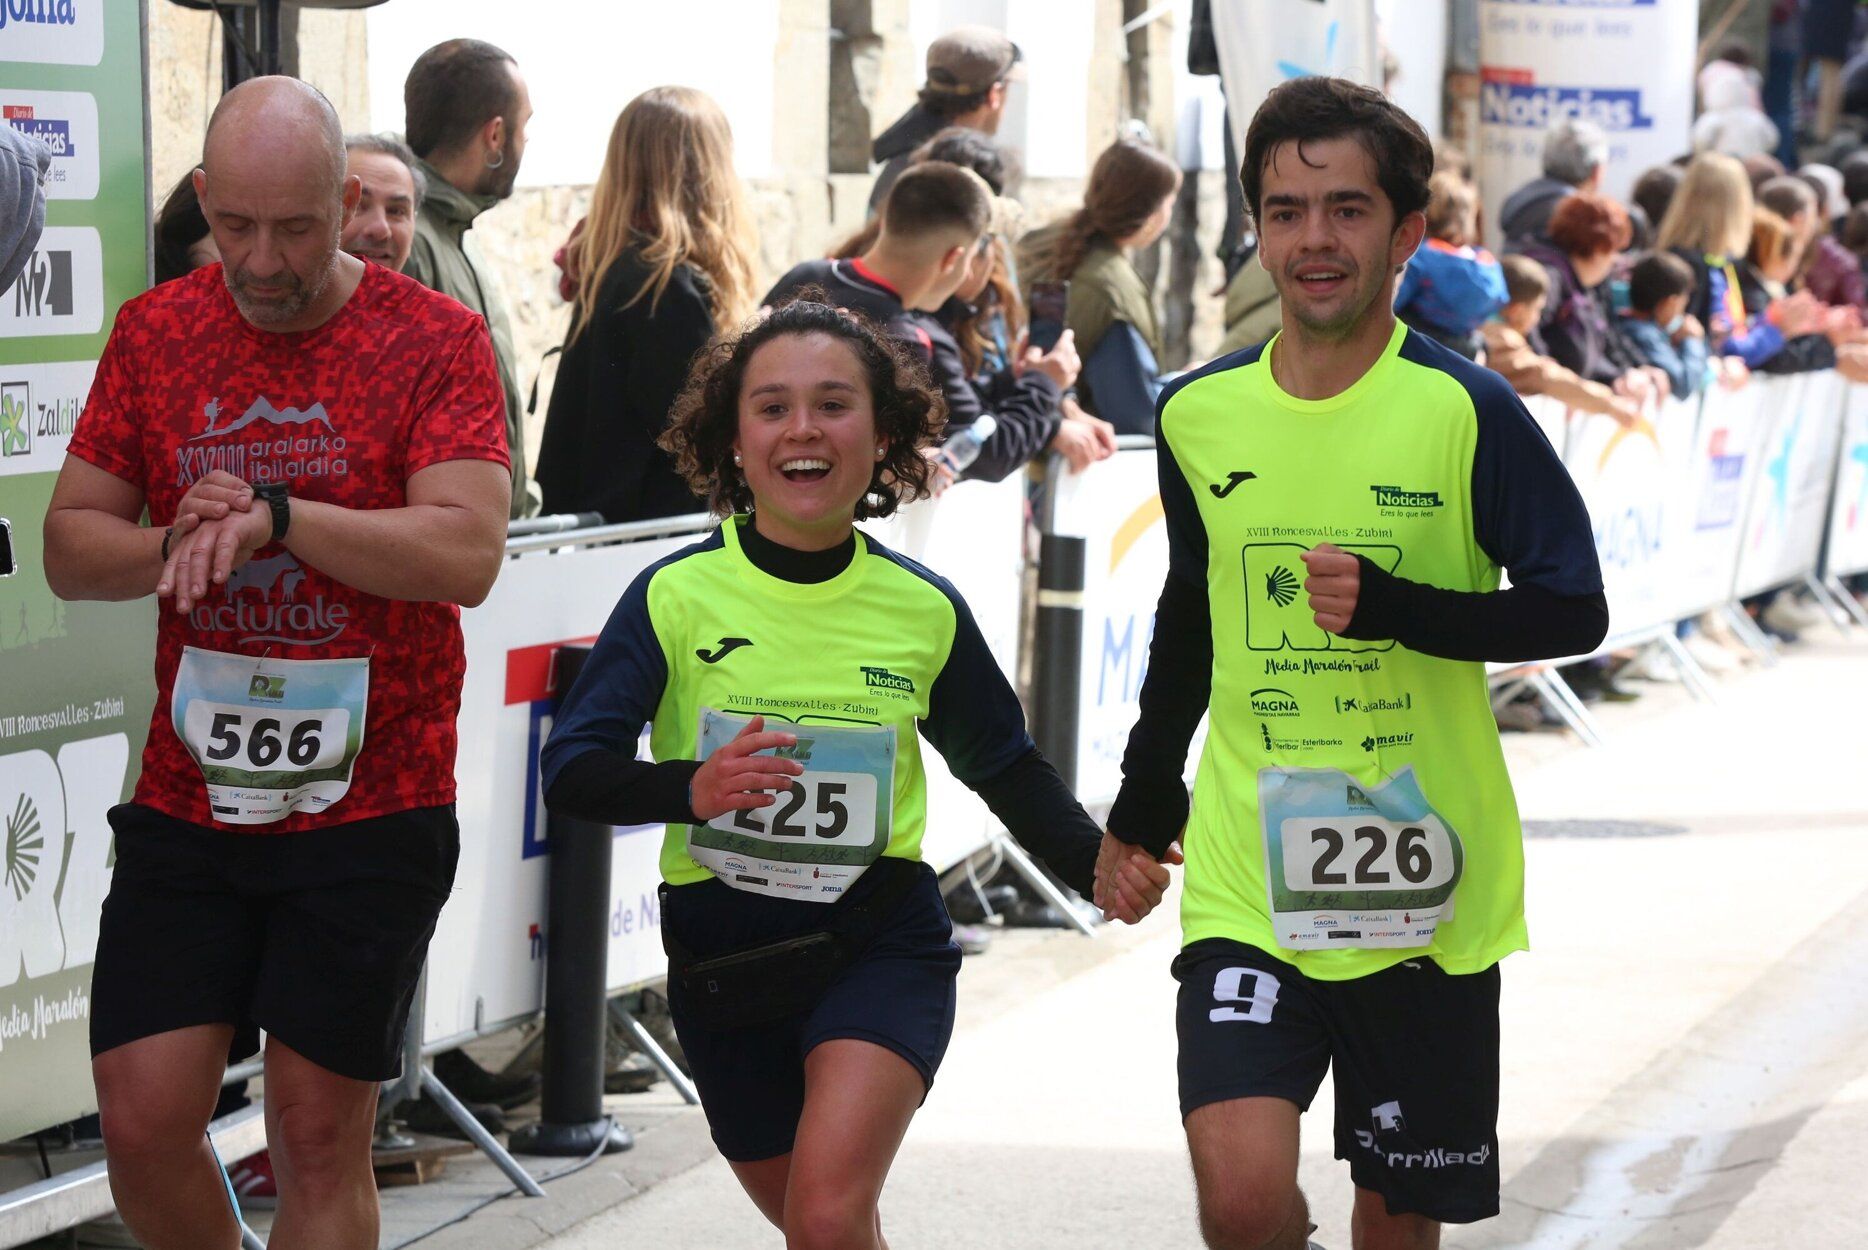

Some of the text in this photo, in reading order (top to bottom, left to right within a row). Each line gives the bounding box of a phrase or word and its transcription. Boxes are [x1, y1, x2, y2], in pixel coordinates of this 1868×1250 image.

[1483, 85, 1633, 127] Noticias
[250, 435, 347, 458] aralarko
[250, 457, 348, 480] ibilaldia
[1379, 492, 1434, 506] Noticias
[1380, 508, 1434, 519] Eres lo que lees
[1246, 526, 1393, 538] XVIII Roncesvalles Zubiri
[1264, 658, 1300, 675] Media
[868, 673, 911, 690] Noticias
[870, 689, 883, 697] Eres
[891, 692, 901, 700] que
[727, 694, 879, 716] XVIII Roncesvalles Zubiri
[1251, 700, 1299, 711] MAGNA
[18, 704, 89, 735] Roncesvalles
[93, 696, 125, 720] Zubiri
[205, 712, 323, 768] 566
[1311, 826, 1432, 884] 226
[725, 861, 747, 871] MAGNA
[780, 883, 812, 891] INTERSPORT
[611, 898, 634, 938] de
[1209, 967, 1281, 1024] 9
